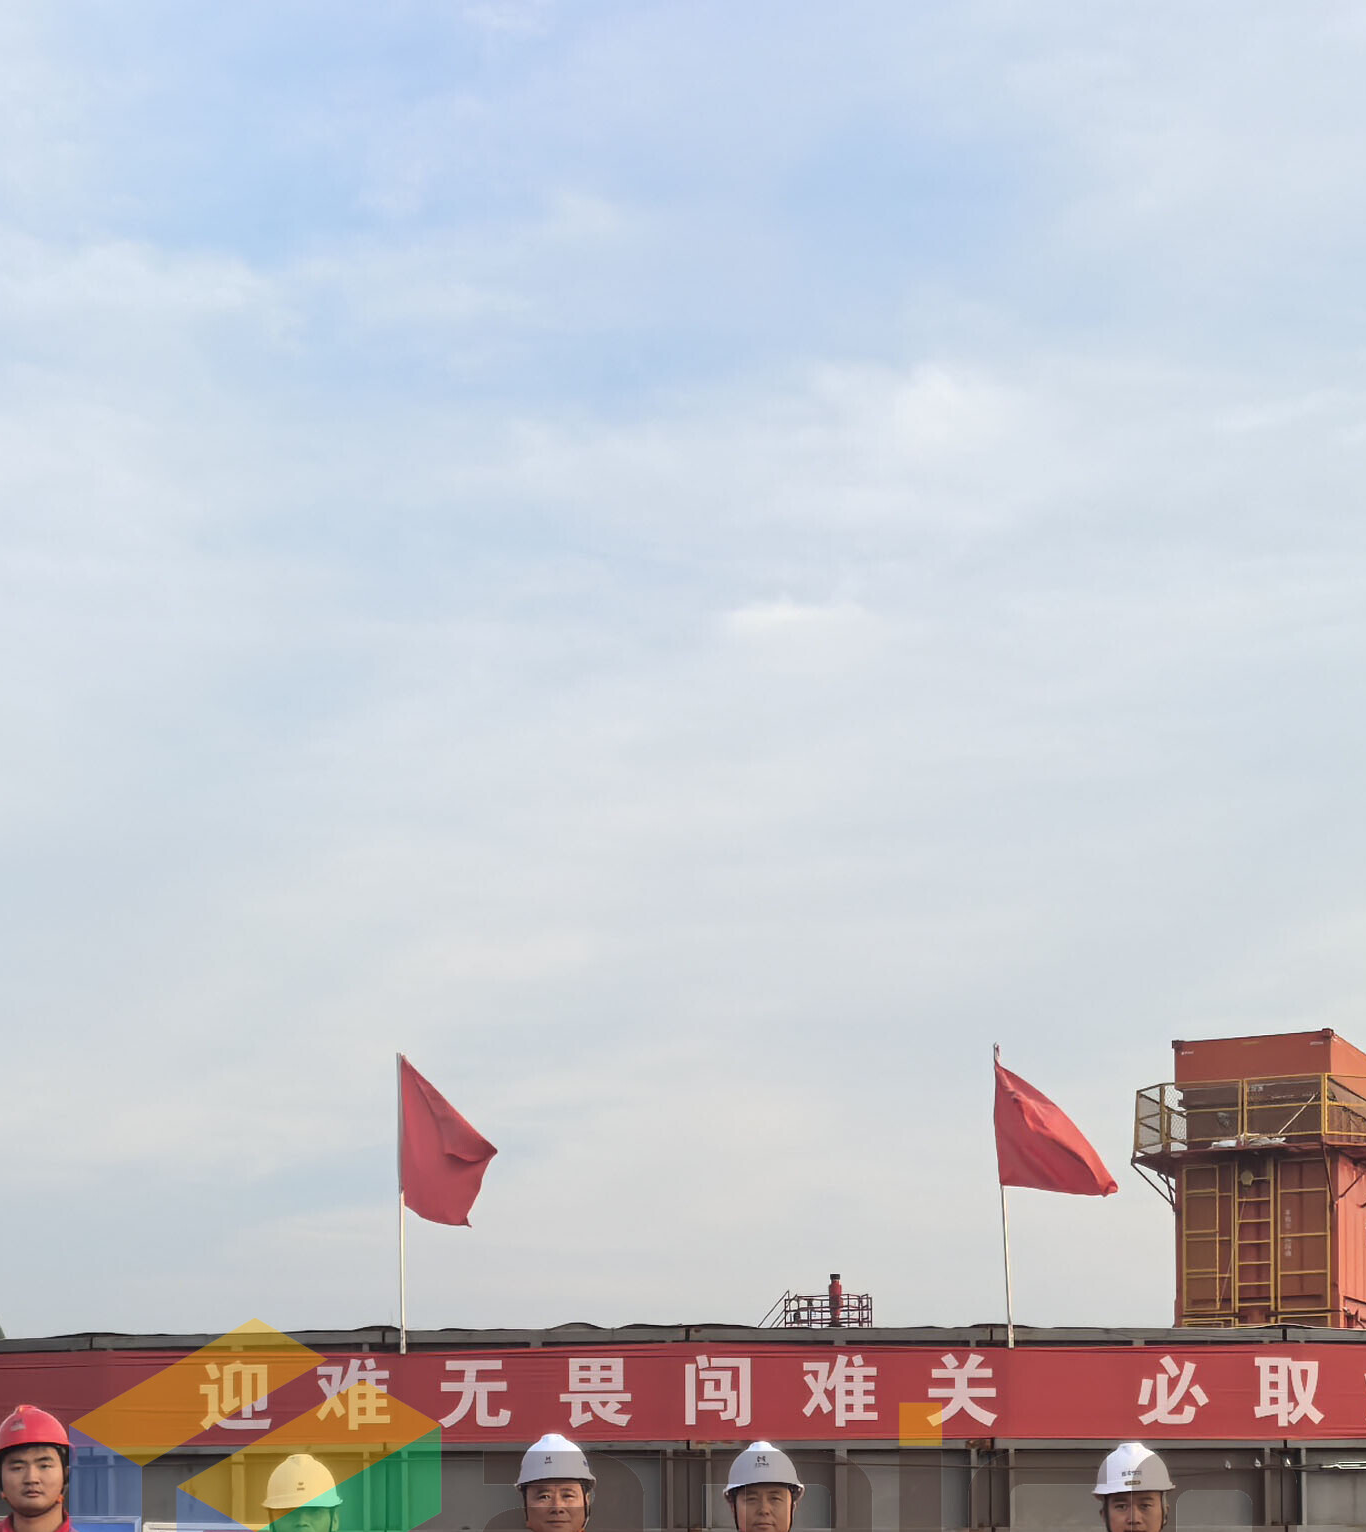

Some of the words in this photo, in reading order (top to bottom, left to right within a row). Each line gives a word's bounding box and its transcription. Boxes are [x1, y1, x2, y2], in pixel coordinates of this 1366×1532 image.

[198, 1353, 998, 1430] 迎难无畏闯难关
